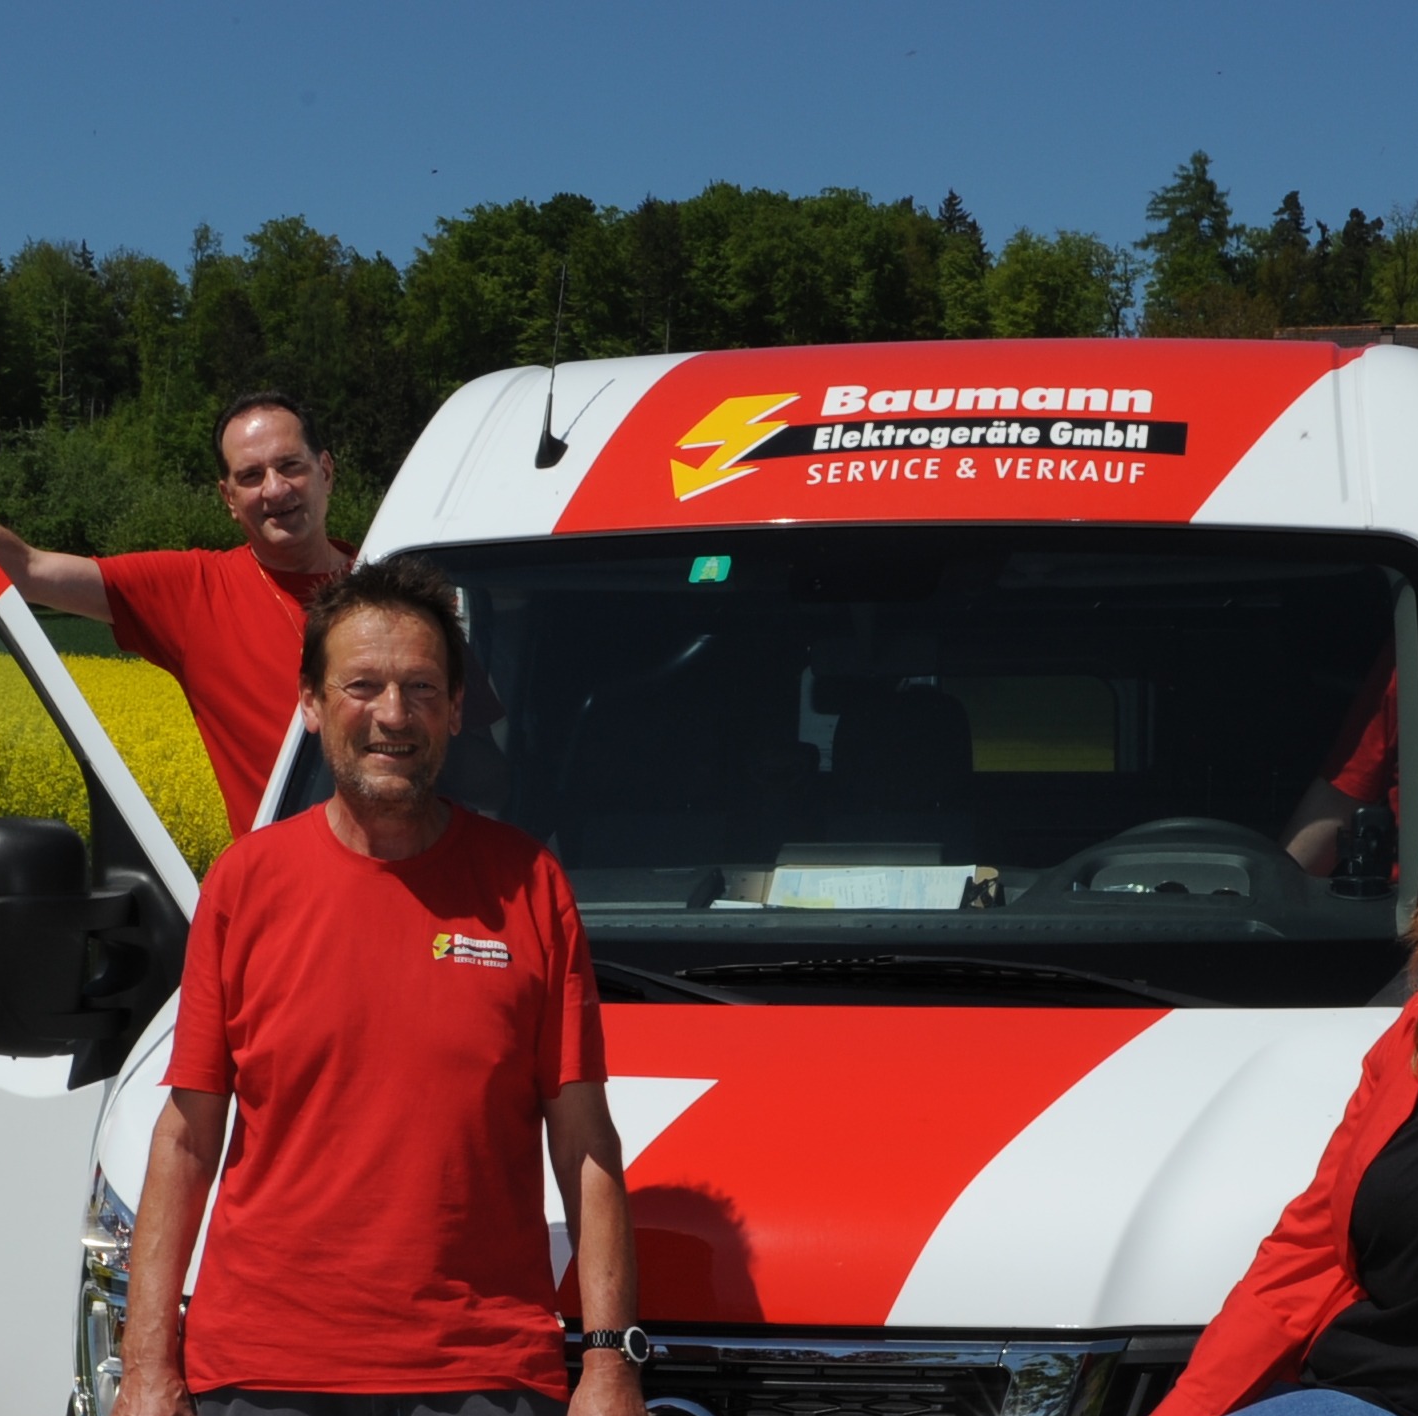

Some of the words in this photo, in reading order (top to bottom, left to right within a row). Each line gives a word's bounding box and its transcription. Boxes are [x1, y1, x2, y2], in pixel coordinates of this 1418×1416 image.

[820, 384, 1154, 418] Baumann
[812, 421, 1042, 452] Elektrogeräte
[1049, 421, 1149, 450] GmbH
[806, 457, 941, 486] SERVICE
[955, 457, 977, 480] &
[994, 457, 1147, 485] VERKAUF
